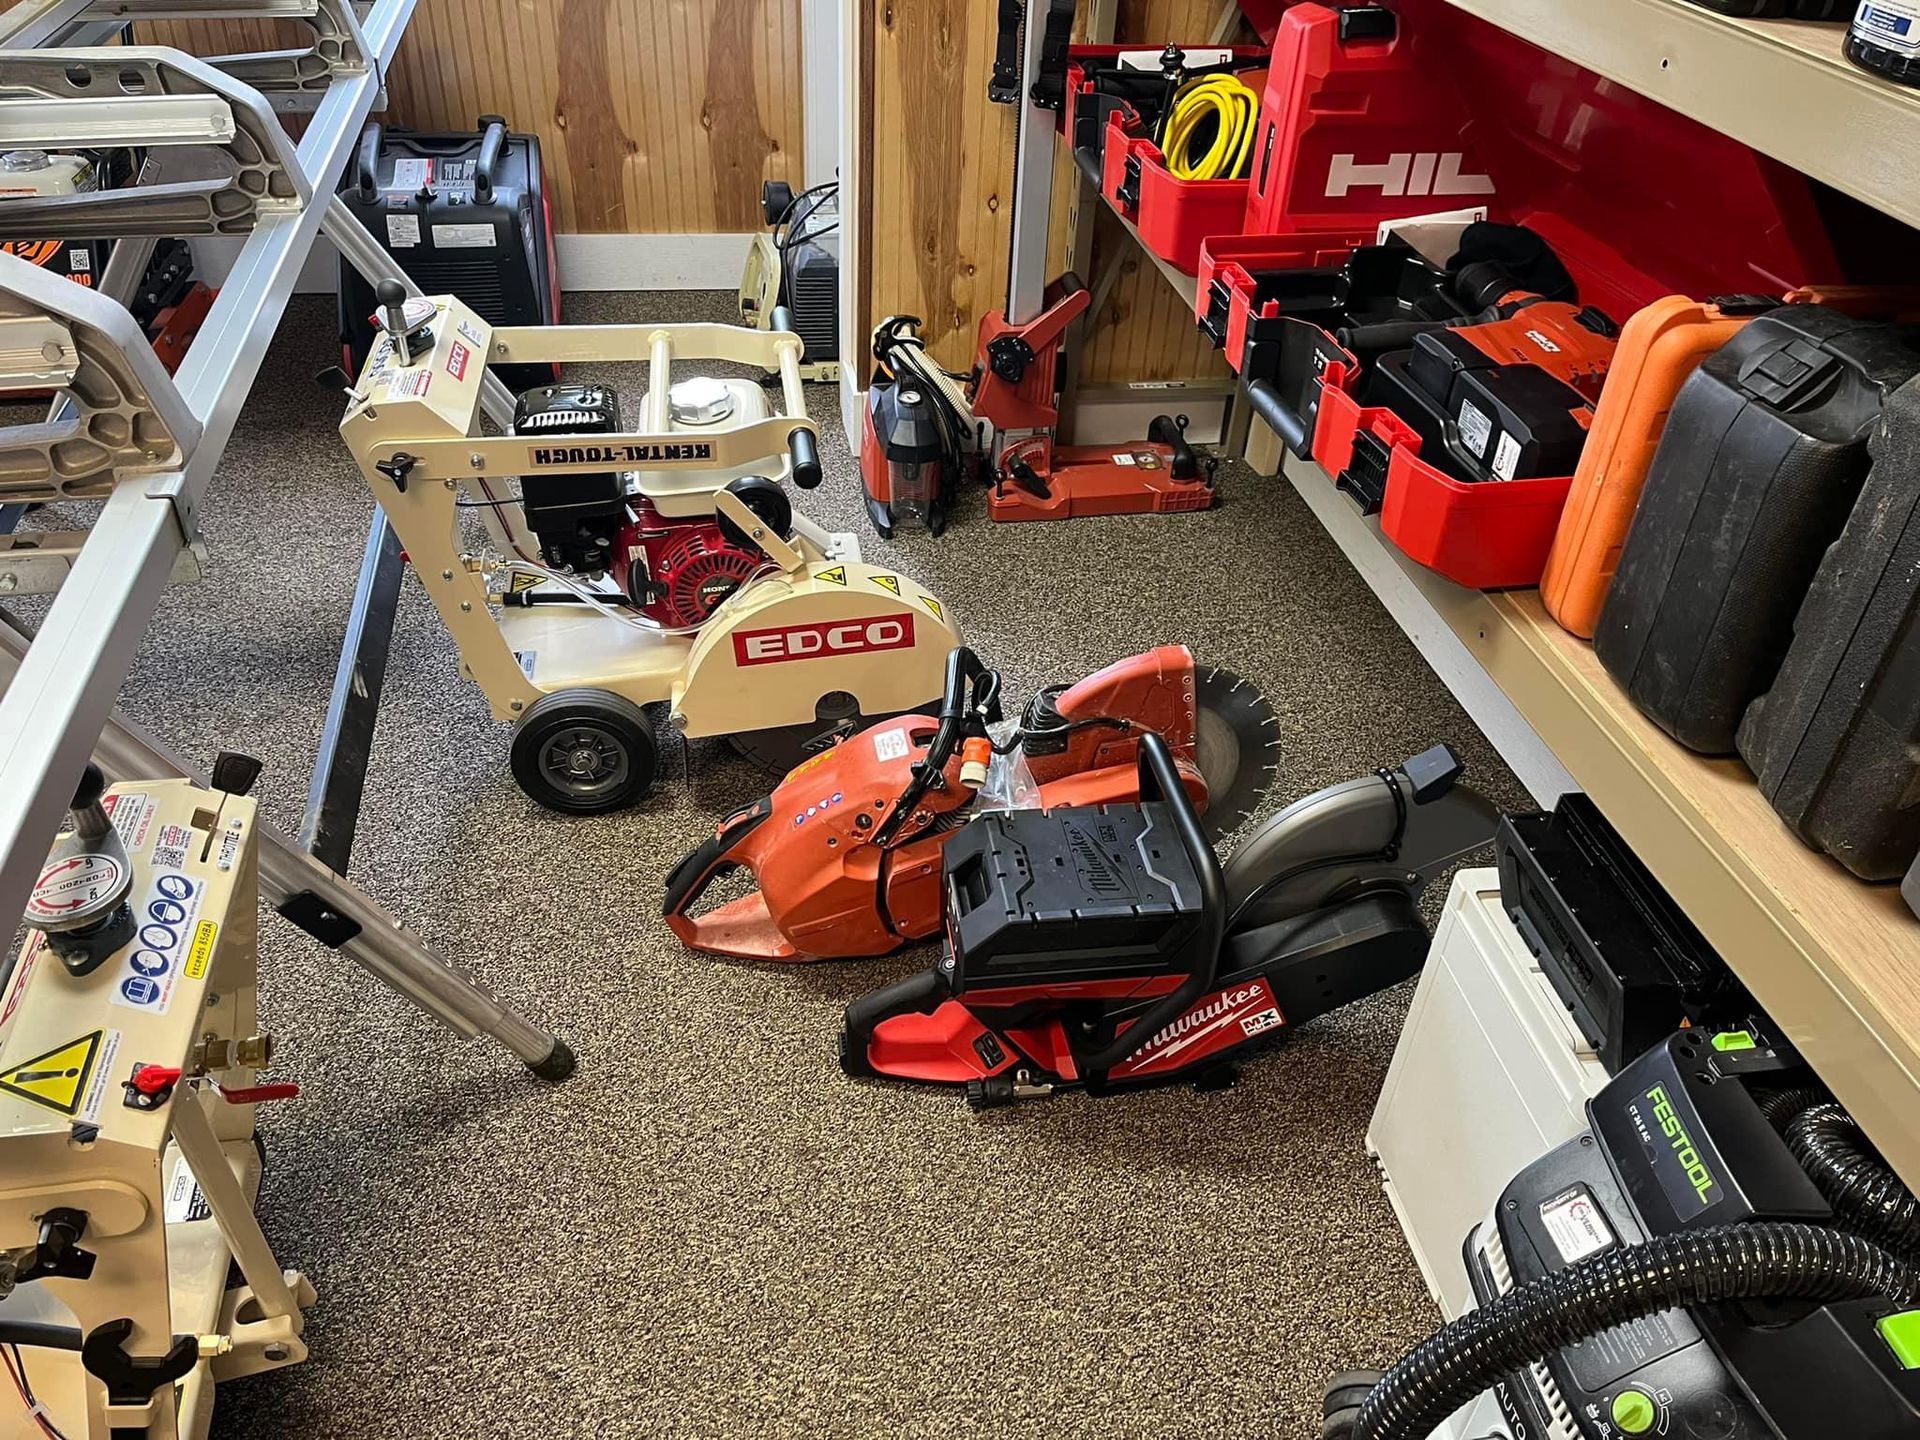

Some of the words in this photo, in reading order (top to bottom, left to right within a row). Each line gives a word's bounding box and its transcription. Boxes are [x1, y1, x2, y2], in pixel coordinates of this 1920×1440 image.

[1325, 152, 1496, 197] HIL
[449, 341, 466, 375] EDCO
[535, 443, 711, 465] RENTAL-TOUGH
[702, 585, 733, 593] HON
[745, 621, 904, 659] EDCO
[220, 830, 240, 863] THROTTLE
[1069, 826, 1121, 893] Milwaukee
[192, 946, 206, 976] exceeds
[199, 923, 212, 946] 85dBA
[1243, 1011, 1276, 1029] MX
[1628, 1104, 1639, 1116] CT
[1641, 1130, 1651, 1142] AC
[1646, 1086, 1713, 1205] FESTOOL
